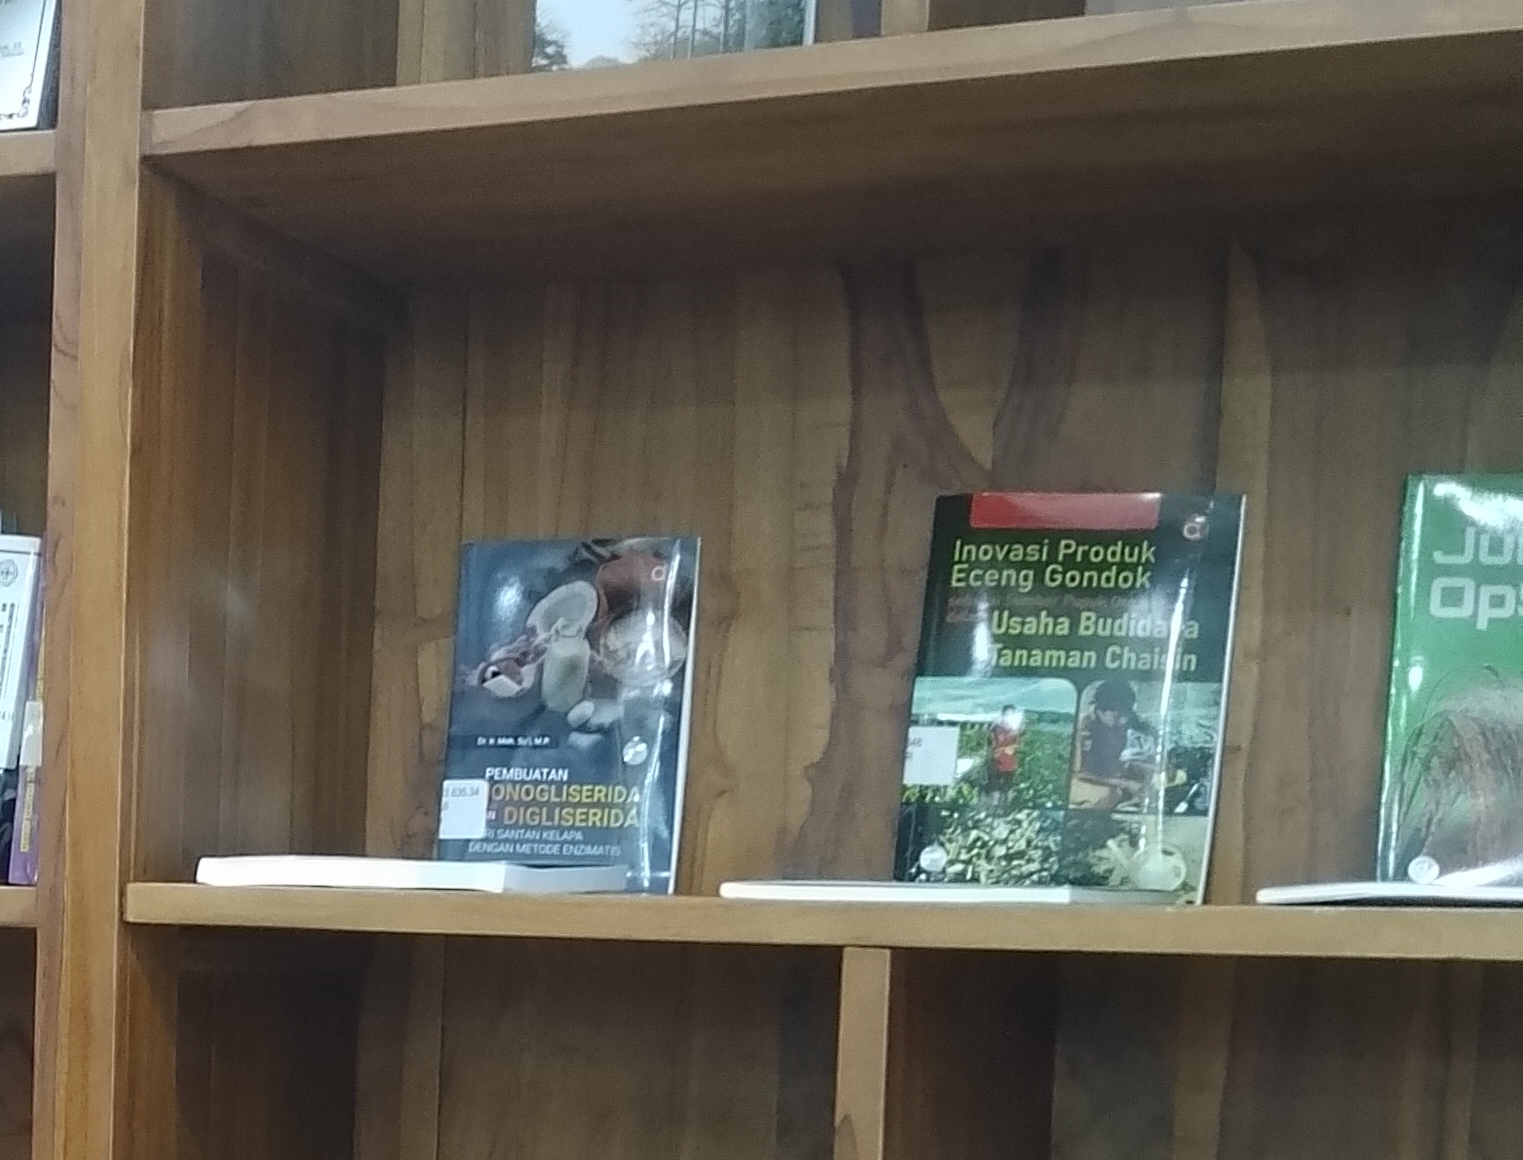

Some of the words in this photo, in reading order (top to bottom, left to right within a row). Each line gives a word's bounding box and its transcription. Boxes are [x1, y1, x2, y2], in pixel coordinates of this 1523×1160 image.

[953, 538, 1049, 563] Inovasi
[1058, 540, 1157, 564] Produk
[950, 564, 1035, 591] Eceng
[1043, 564, 1152, 590] Gondok
[991, 610, 1070, 637] Usaha
[484, 767, 569, 781] PEMBUATAN
[503, 806, 641, 828] DIGLISERIDA
[496, 828, 540, 841] SANTAN
[541, 829, 584, 841] KELAPA
[468, 841, 514, 854] DENGAN
[515, 842, 561, 855] METODE
